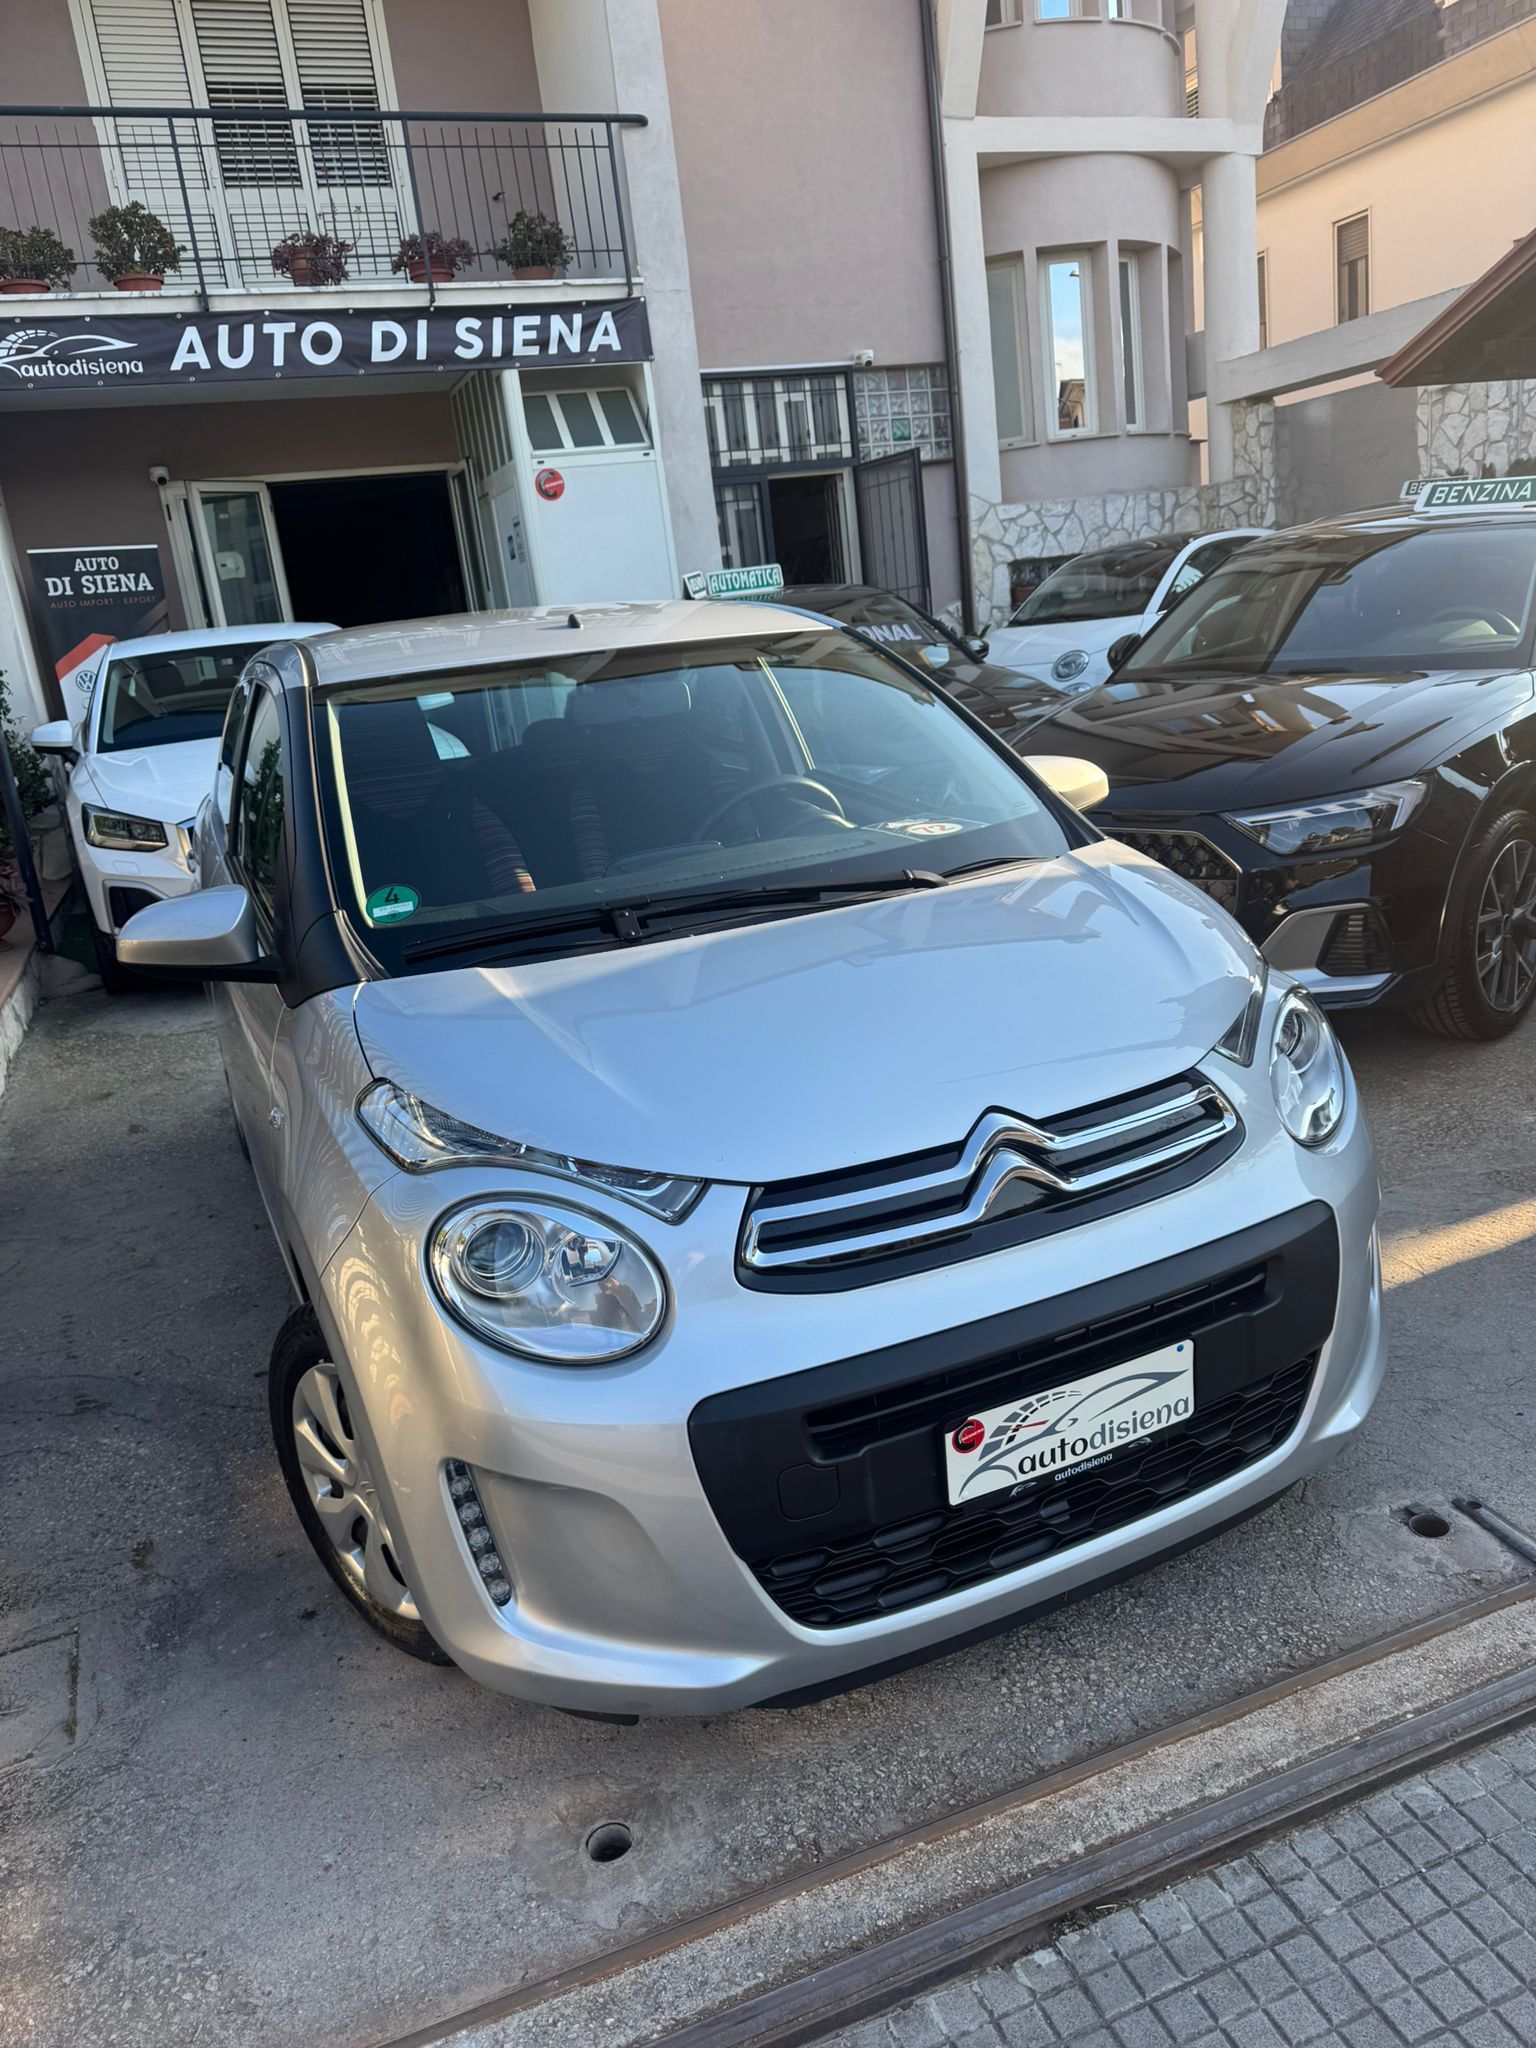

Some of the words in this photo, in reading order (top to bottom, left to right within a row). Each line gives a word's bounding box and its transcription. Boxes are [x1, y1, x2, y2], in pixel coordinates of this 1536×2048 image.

[170, 321, 342, 371] AUTO
[371, 319, 428, 362] DI
[454, 311, 622, 359] SIENA
[20, 358, 144, 377] autodisiena
[1431, 482, 1532, 504] BENZINA
[74, 556, 119, 572] AUTO
[45, 576, 74, 596] DI
[81, 572, 154, 594] SIENA
[710, 567, 780, 592] AUTOMATICA
[50, 600, 76, 609] AUTO
[80, 598, 113, 607] IMPORT
[124, 596, 156, 605] EXPORT
[385, 887, 400, 903] 4
[1018, 1396, 1189, 1475] autodisiena
[1055, 1453, 1113, 1482] autodisiena
